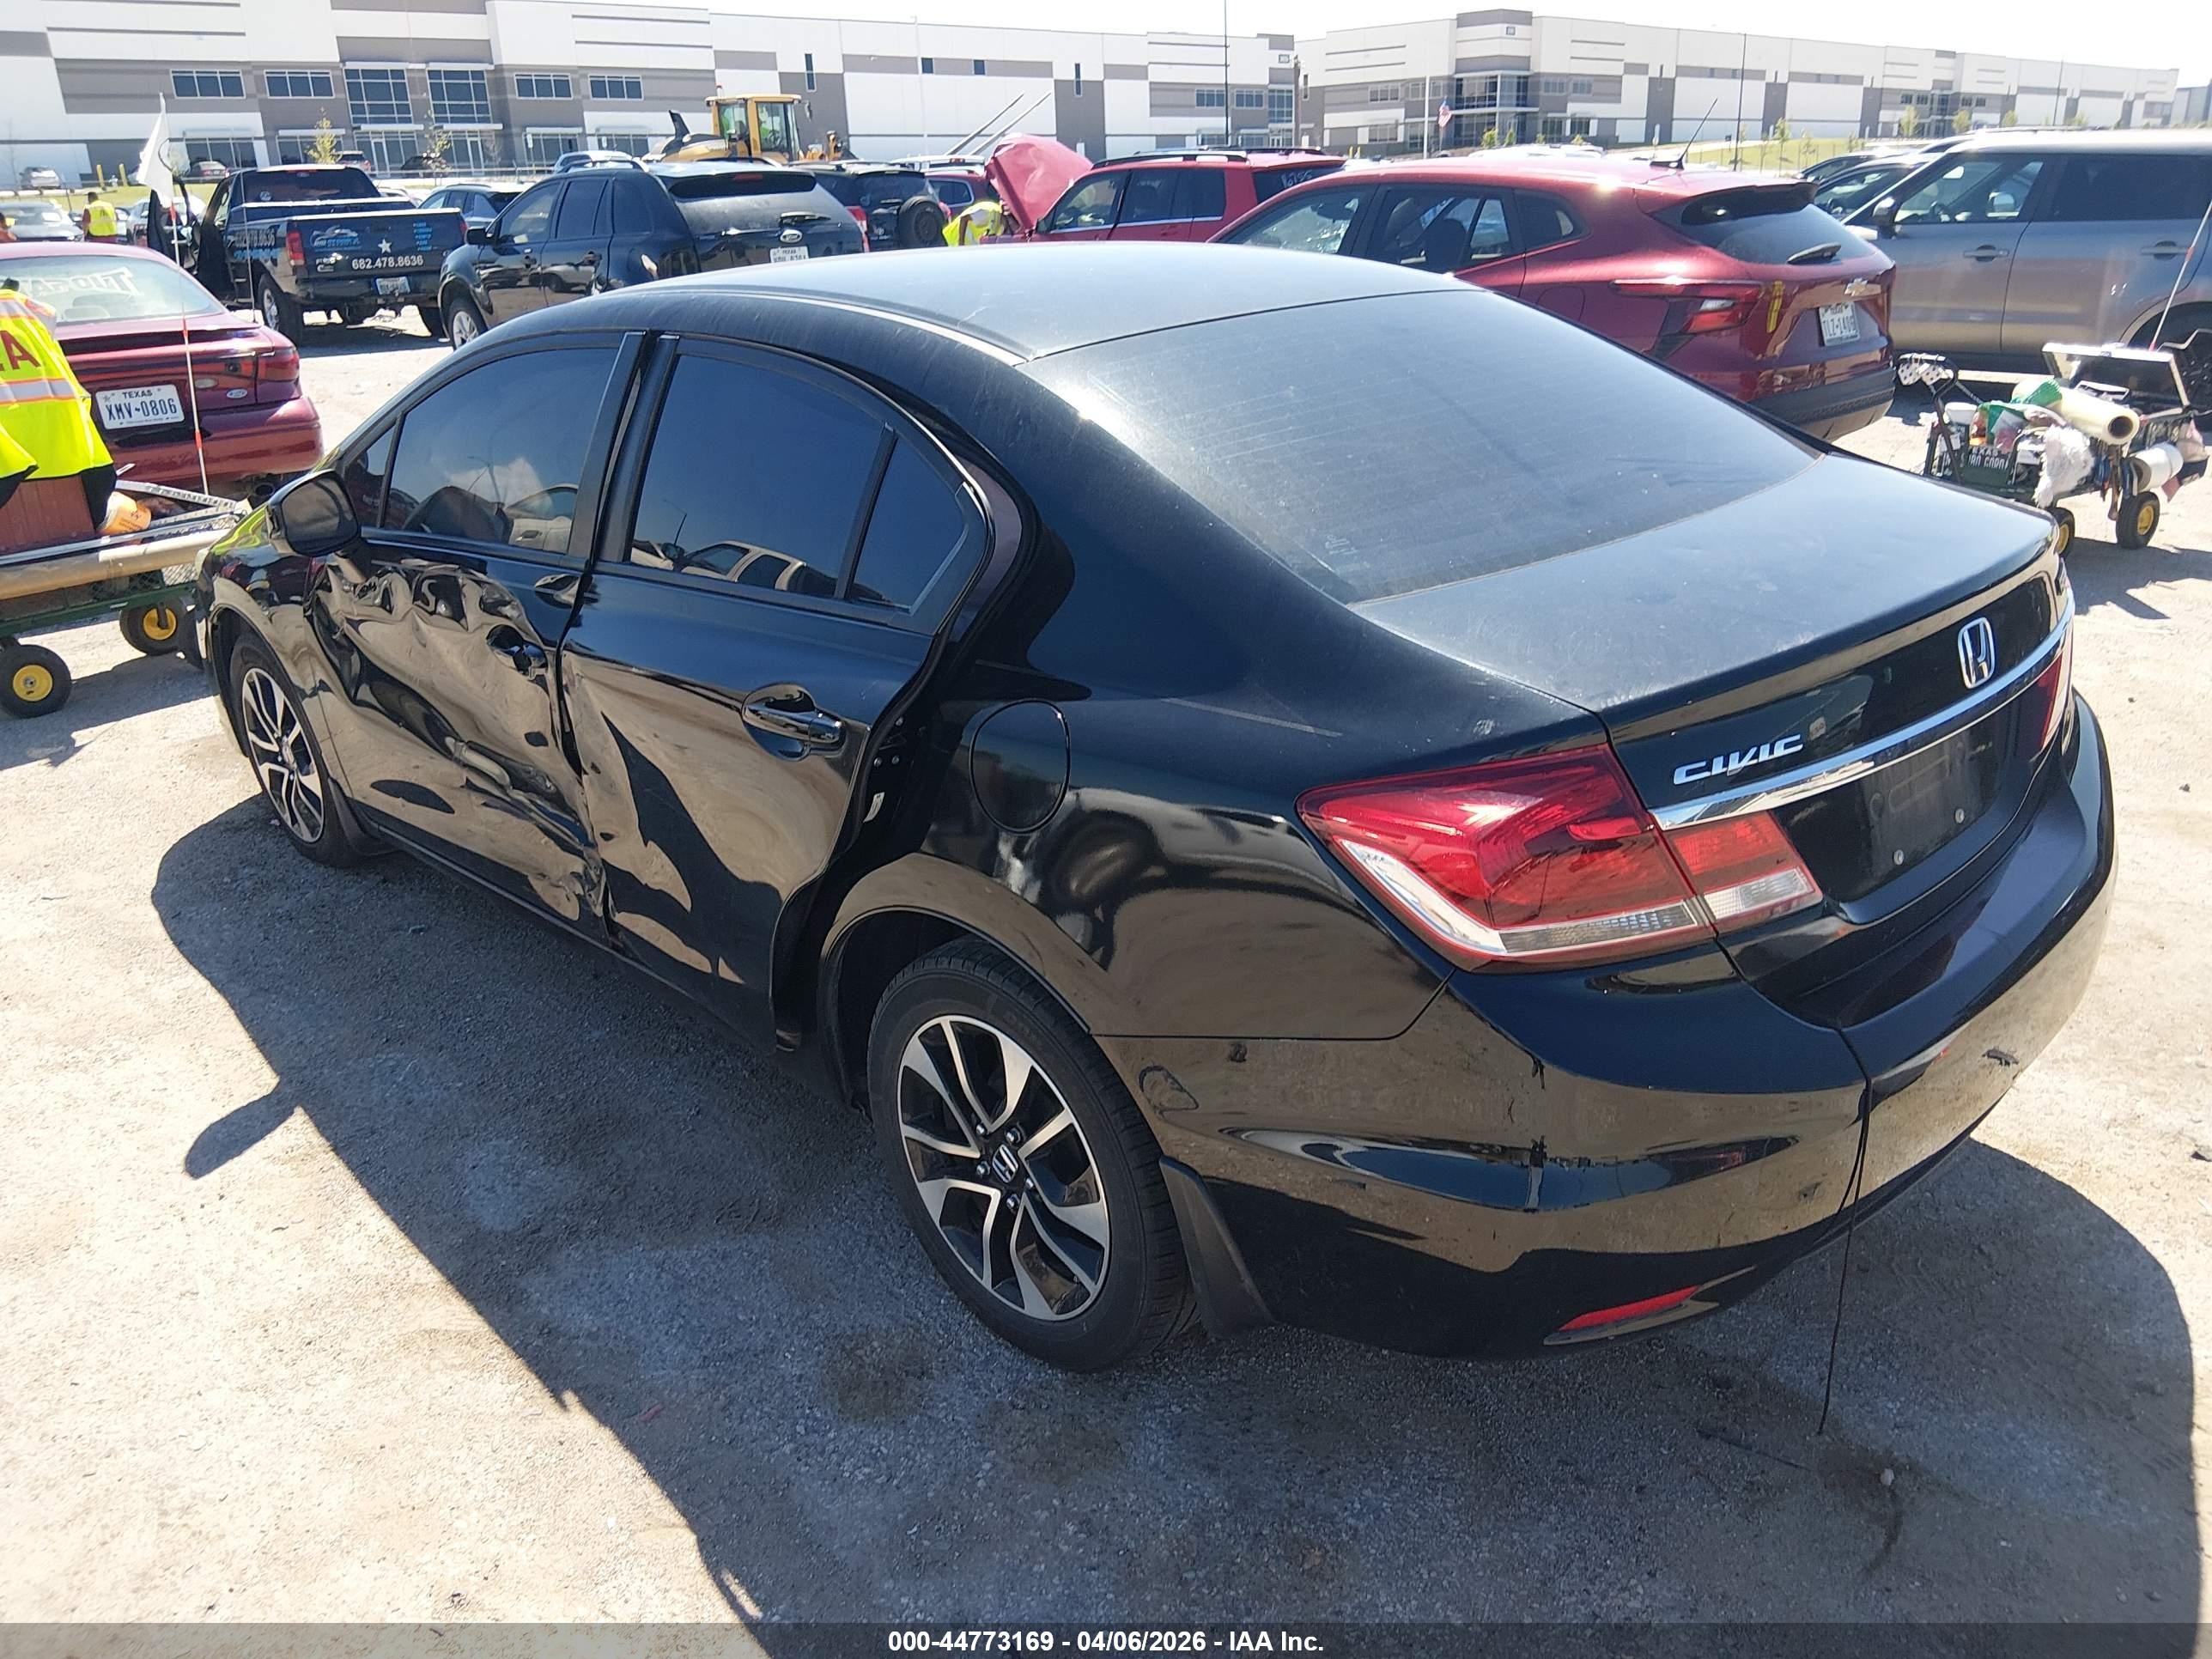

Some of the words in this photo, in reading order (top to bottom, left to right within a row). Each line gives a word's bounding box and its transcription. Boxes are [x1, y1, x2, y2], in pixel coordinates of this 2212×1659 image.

[351, 254, 424, 270] 682.478.8636
[122, 389, 153, 399] TEXAS
[1674, 733, 1803, 785] CIVIC
